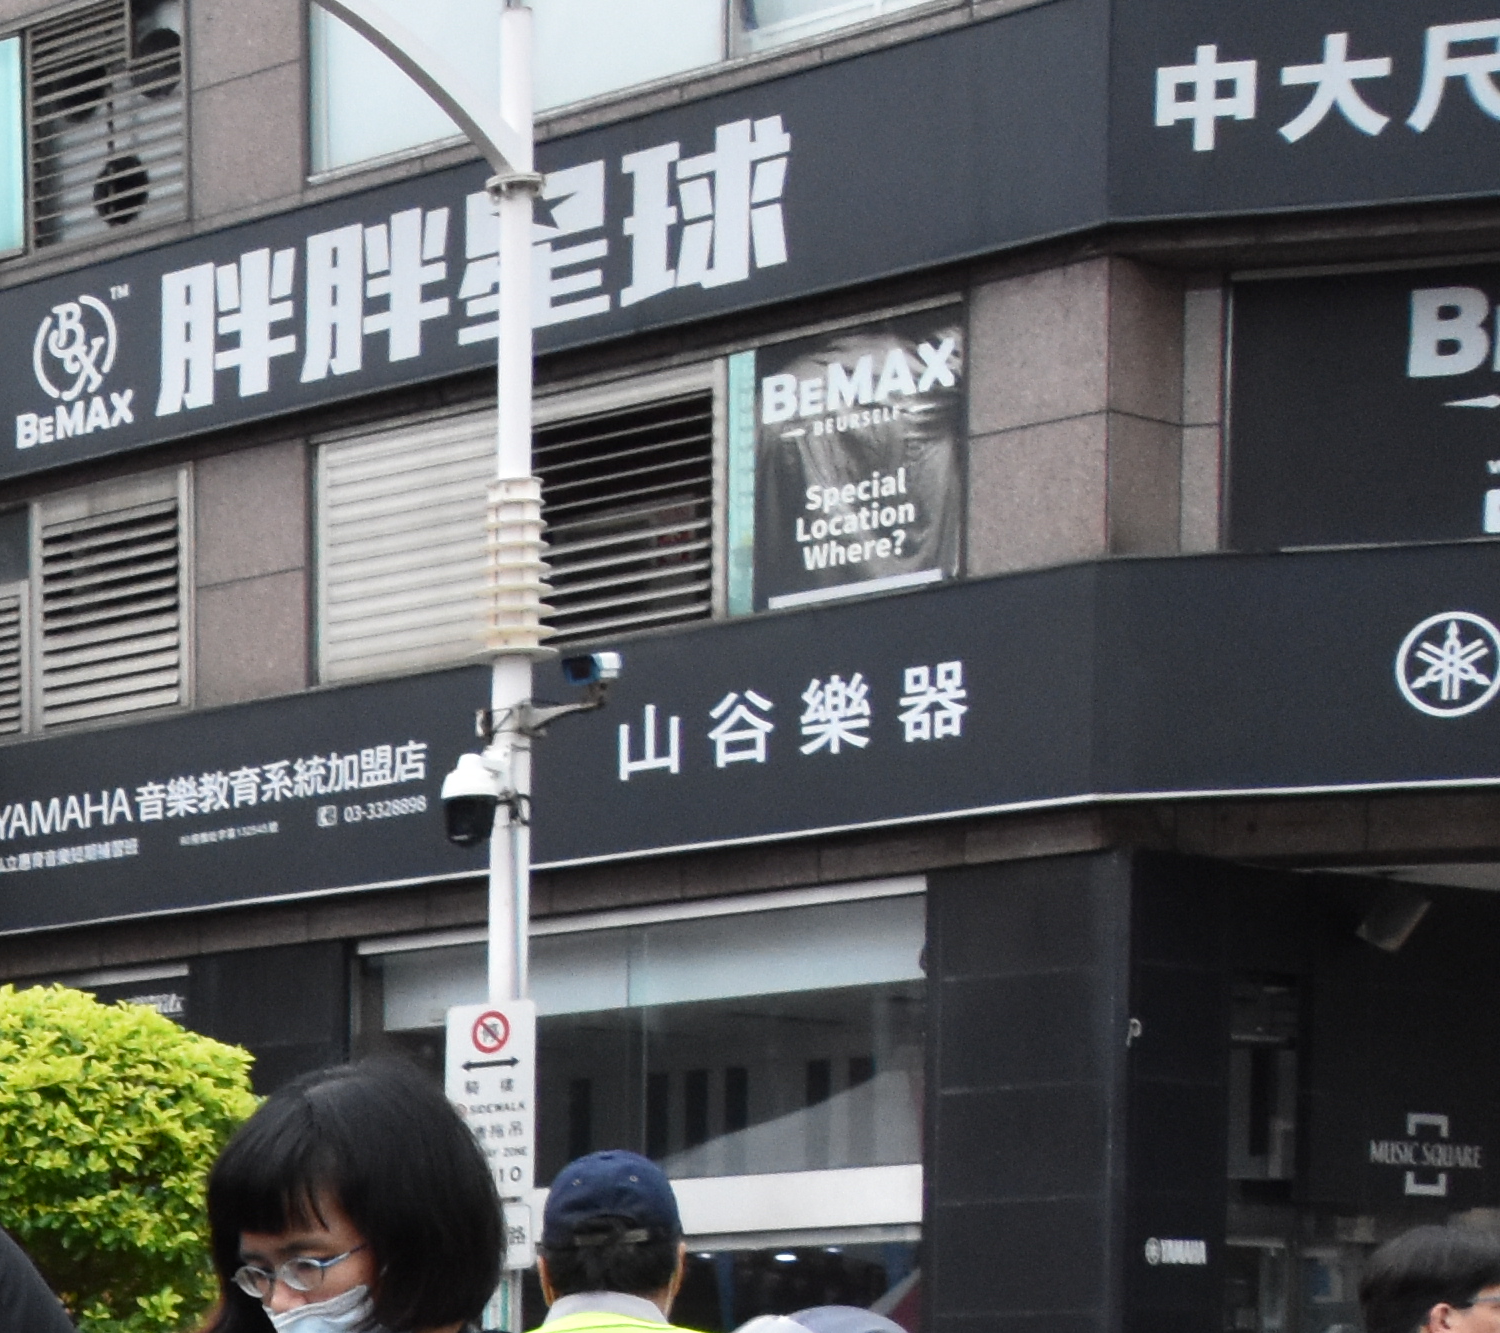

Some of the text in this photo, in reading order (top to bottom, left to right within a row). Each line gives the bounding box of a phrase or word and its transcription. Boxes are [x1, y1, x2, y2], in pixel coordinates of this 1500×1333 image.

[156, 114, 792, 416] 胖胖星球
[813, 405, 902, 437] BEURSELF
[805, 467, 907, 514] Special
[796, 502, 916, 542] Location
[802, 529, 907, 570] Where?
[618, 661, 968, 781] 山谷樂器
[134, 739, 429, 823] 音樂教育系統加盟店
[1369, 1139, 1418, 1165] MUSIC
